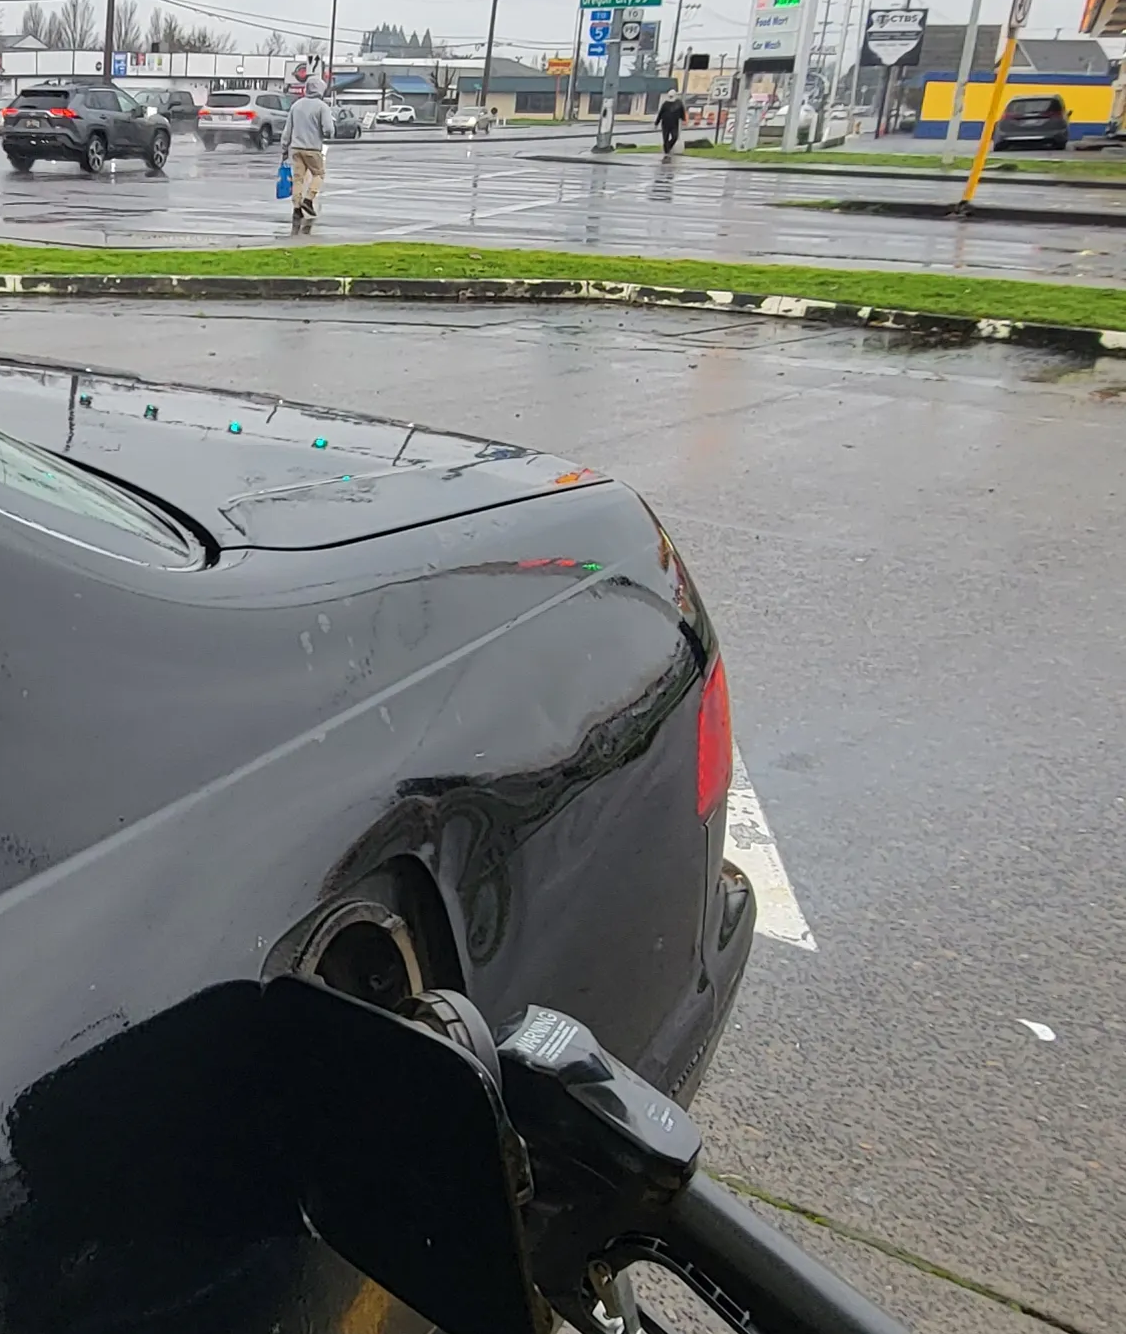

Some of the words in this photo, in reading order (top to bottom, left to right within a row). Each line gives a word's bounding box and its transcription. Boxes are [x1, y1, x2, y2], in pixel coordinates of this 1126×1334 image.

[594, 26, 604, 40] 5
[714, 86, 729, 98] 35
[515, 1010, 558, 1053] WARNING
